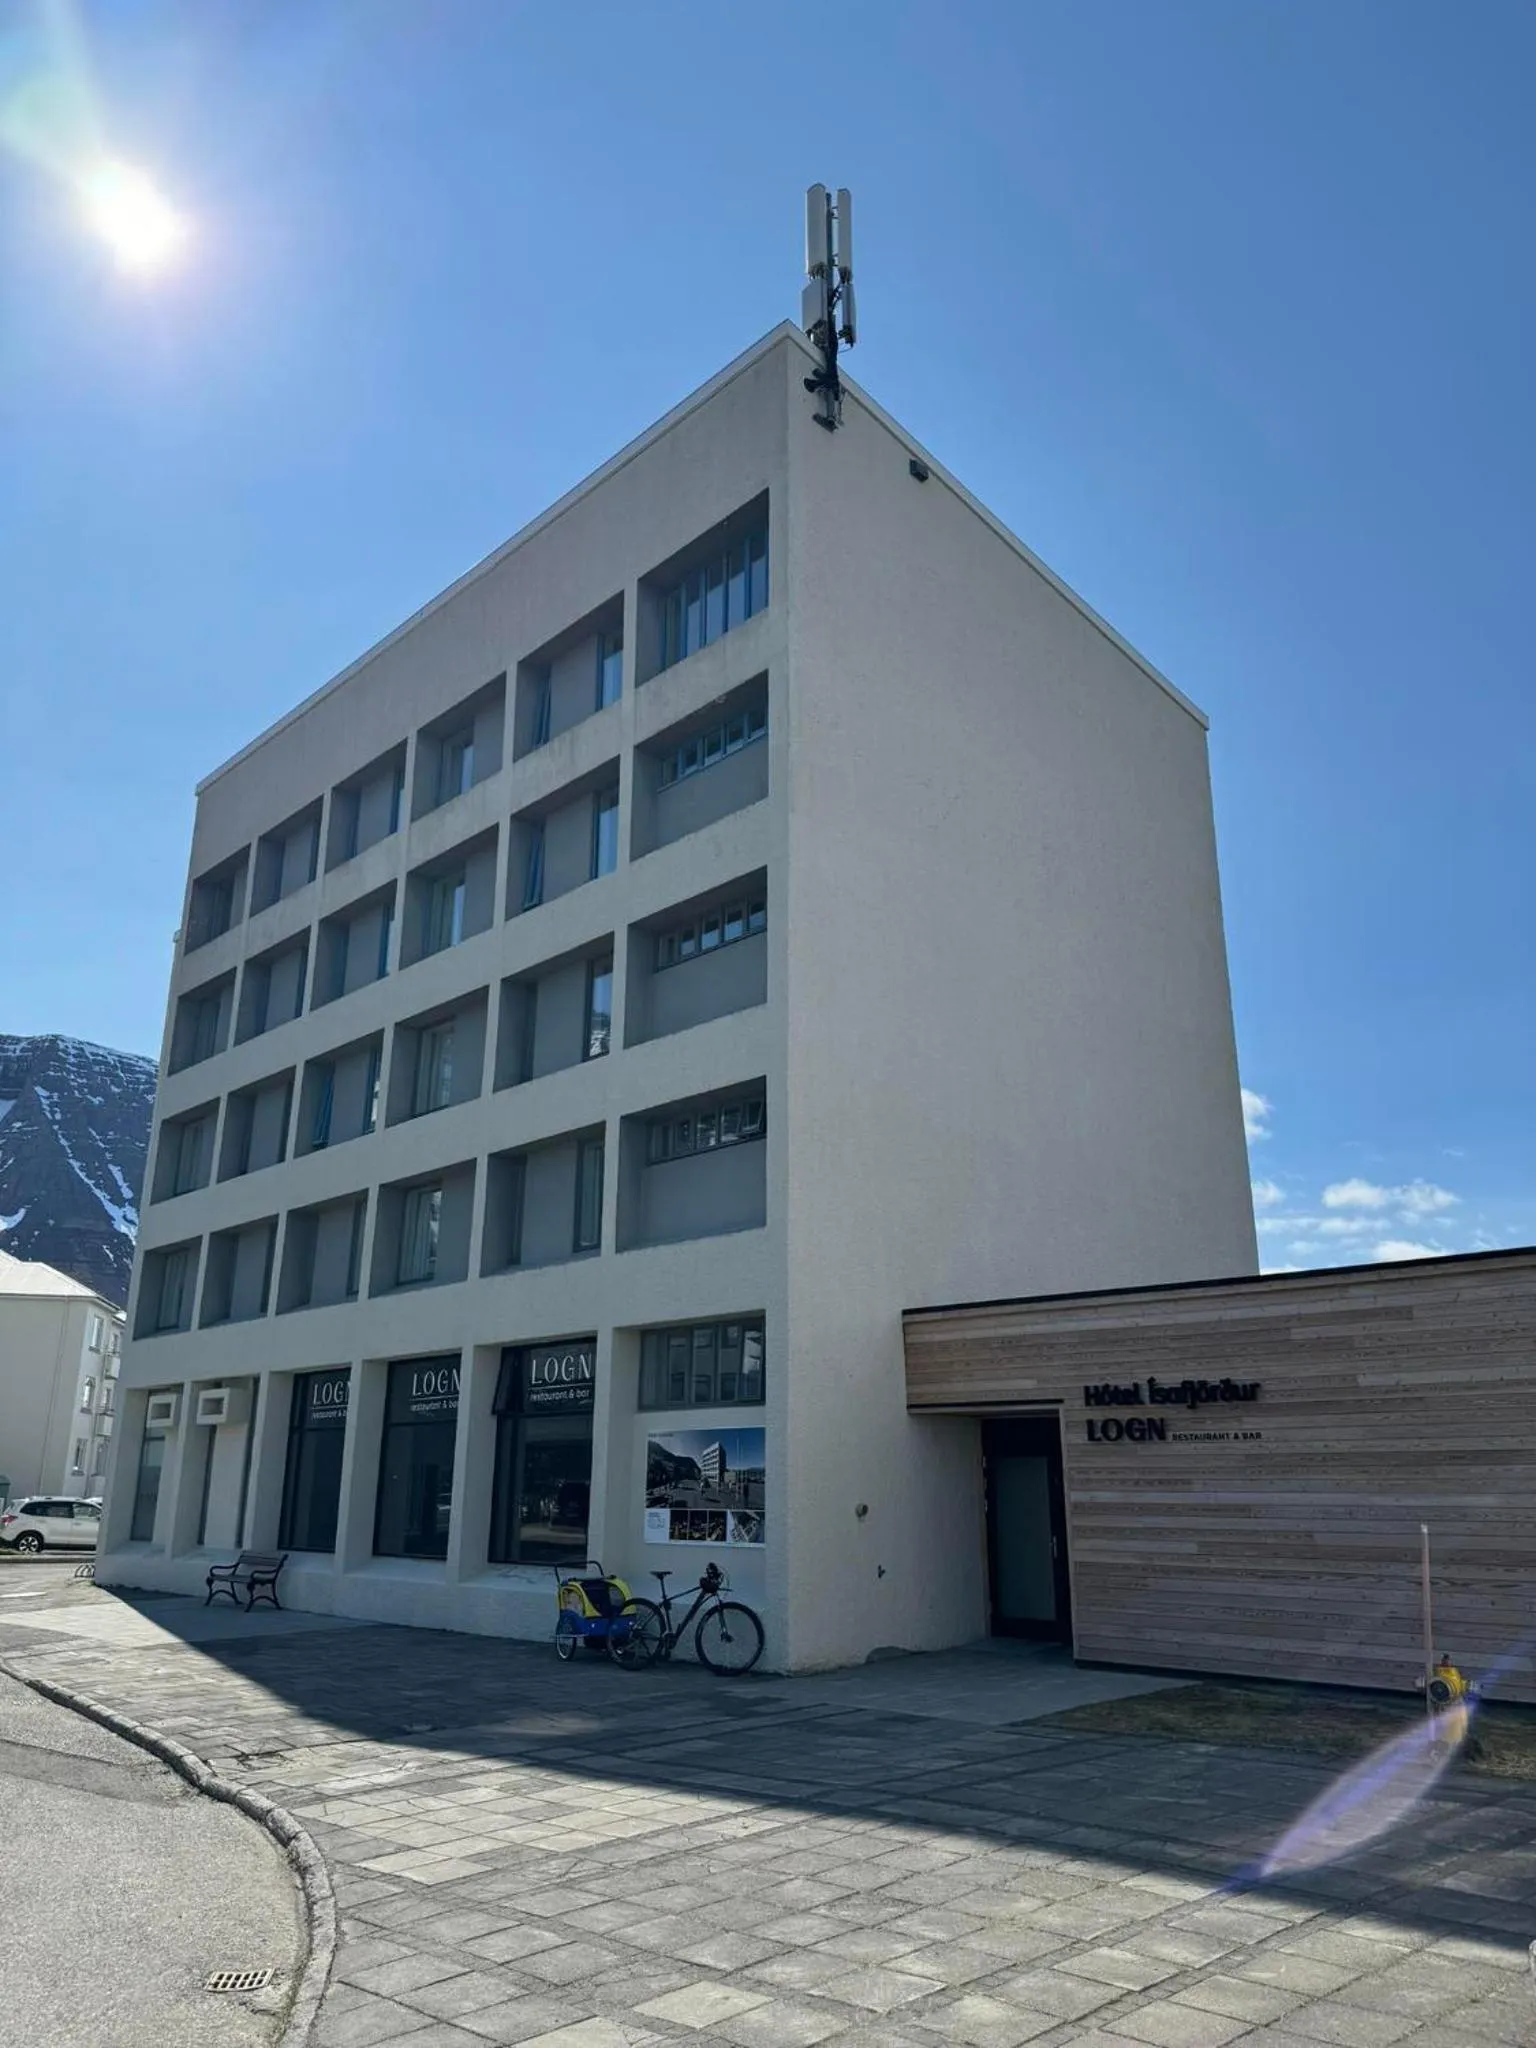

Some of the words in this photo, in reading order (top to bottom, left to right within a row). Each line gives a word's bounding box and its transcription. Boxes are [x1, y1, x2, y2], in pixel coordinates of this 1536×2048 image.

[532, 1354, 592, 1384] LOGN
[1087, 1417, 1166, 1442] LOGN
[1172, 1432, 1230, 1441] RESTAURANT
[1242, 1431, 1262, 1440] BAR
